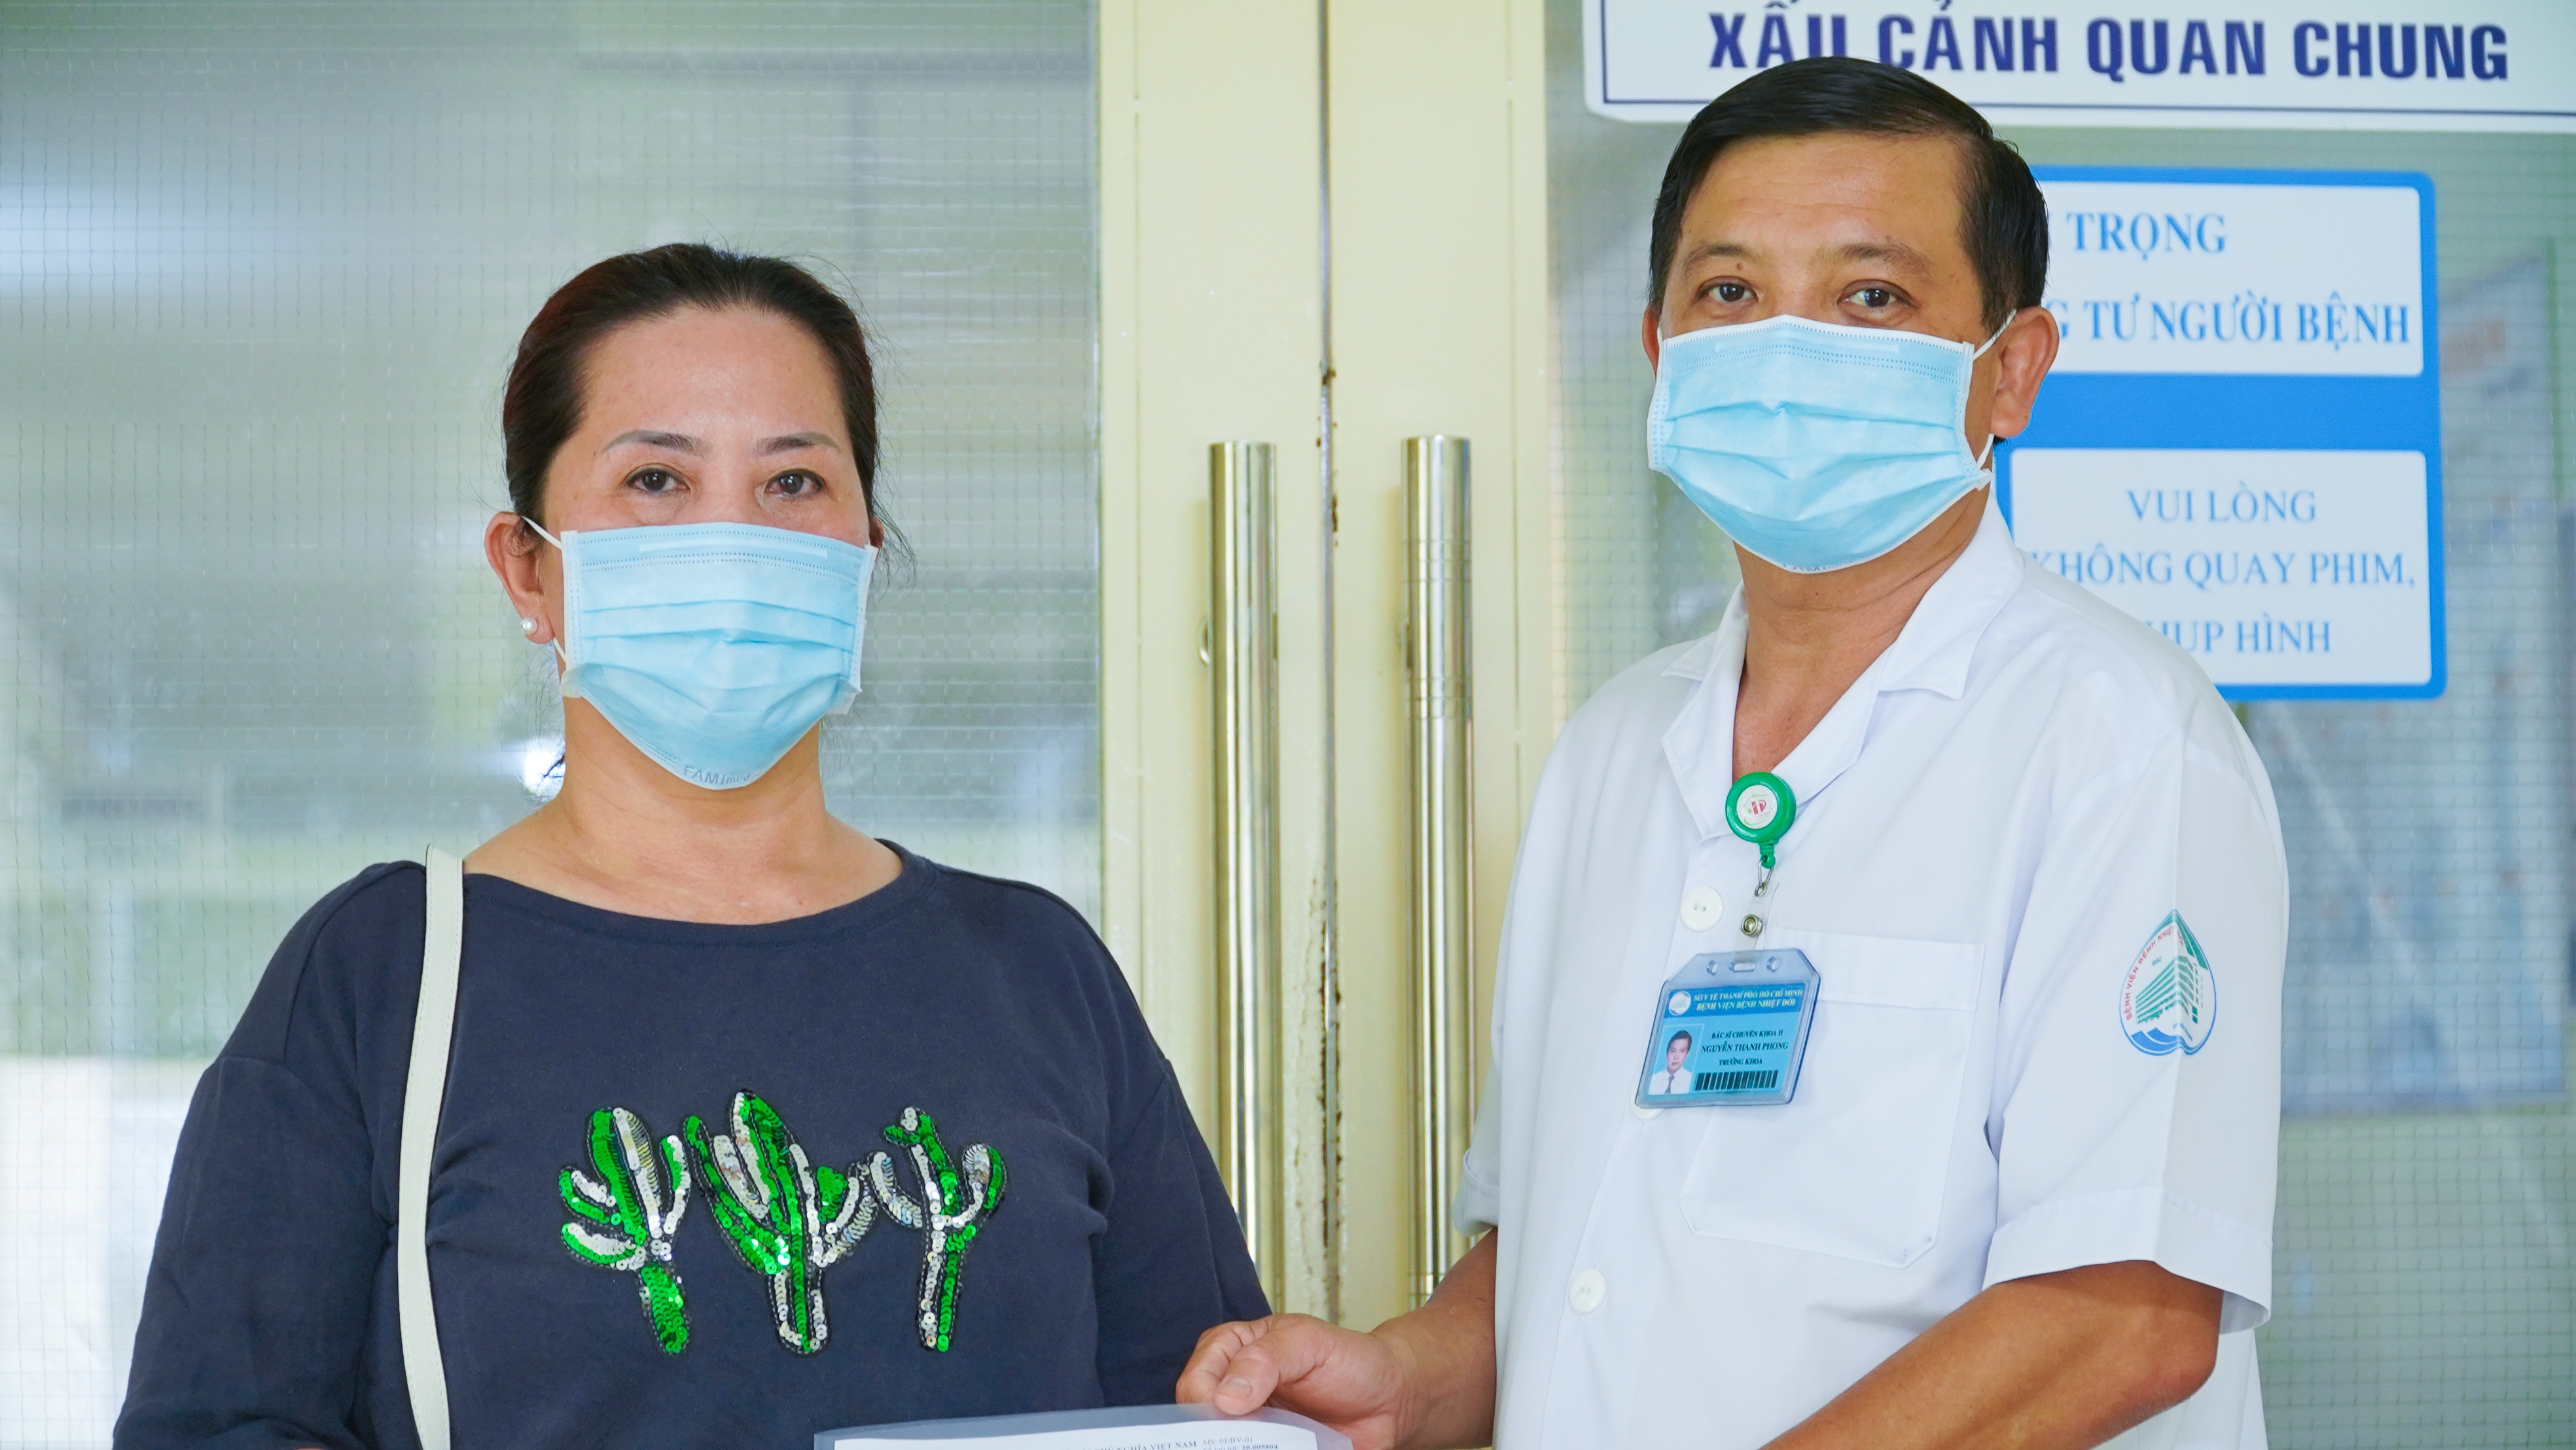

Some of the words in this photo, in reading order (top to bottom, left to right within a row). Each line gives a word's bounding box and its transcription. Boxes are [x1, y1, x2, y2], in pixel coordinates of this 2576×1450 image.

[1878, 0, 2058, 72] CẢNH
[2086, 18, 2266, 83] QUAN
[2293, 22, 2509, 80] CHUNG
[2066, 212, 2228, 261] TRỌNG
[2084, 293, 2141, 341] TƯ
[2151, 289, 2283, 344] NGƯỜI
[2297, 290, 2410, 352] BỆNH
[2128, 489, 2193, 522] VUI
[2208, 480, 2316, 522] LÒNG
[2185, 552, 2295, 590] QUAY
[2310, 552, 2416, 589] PHIM,
[2237, 611, 2330, 652] HÌNH
[1734, 1042, 1761, 1052] THANH
[1762, 1042, 1789, 1051] PHONG
